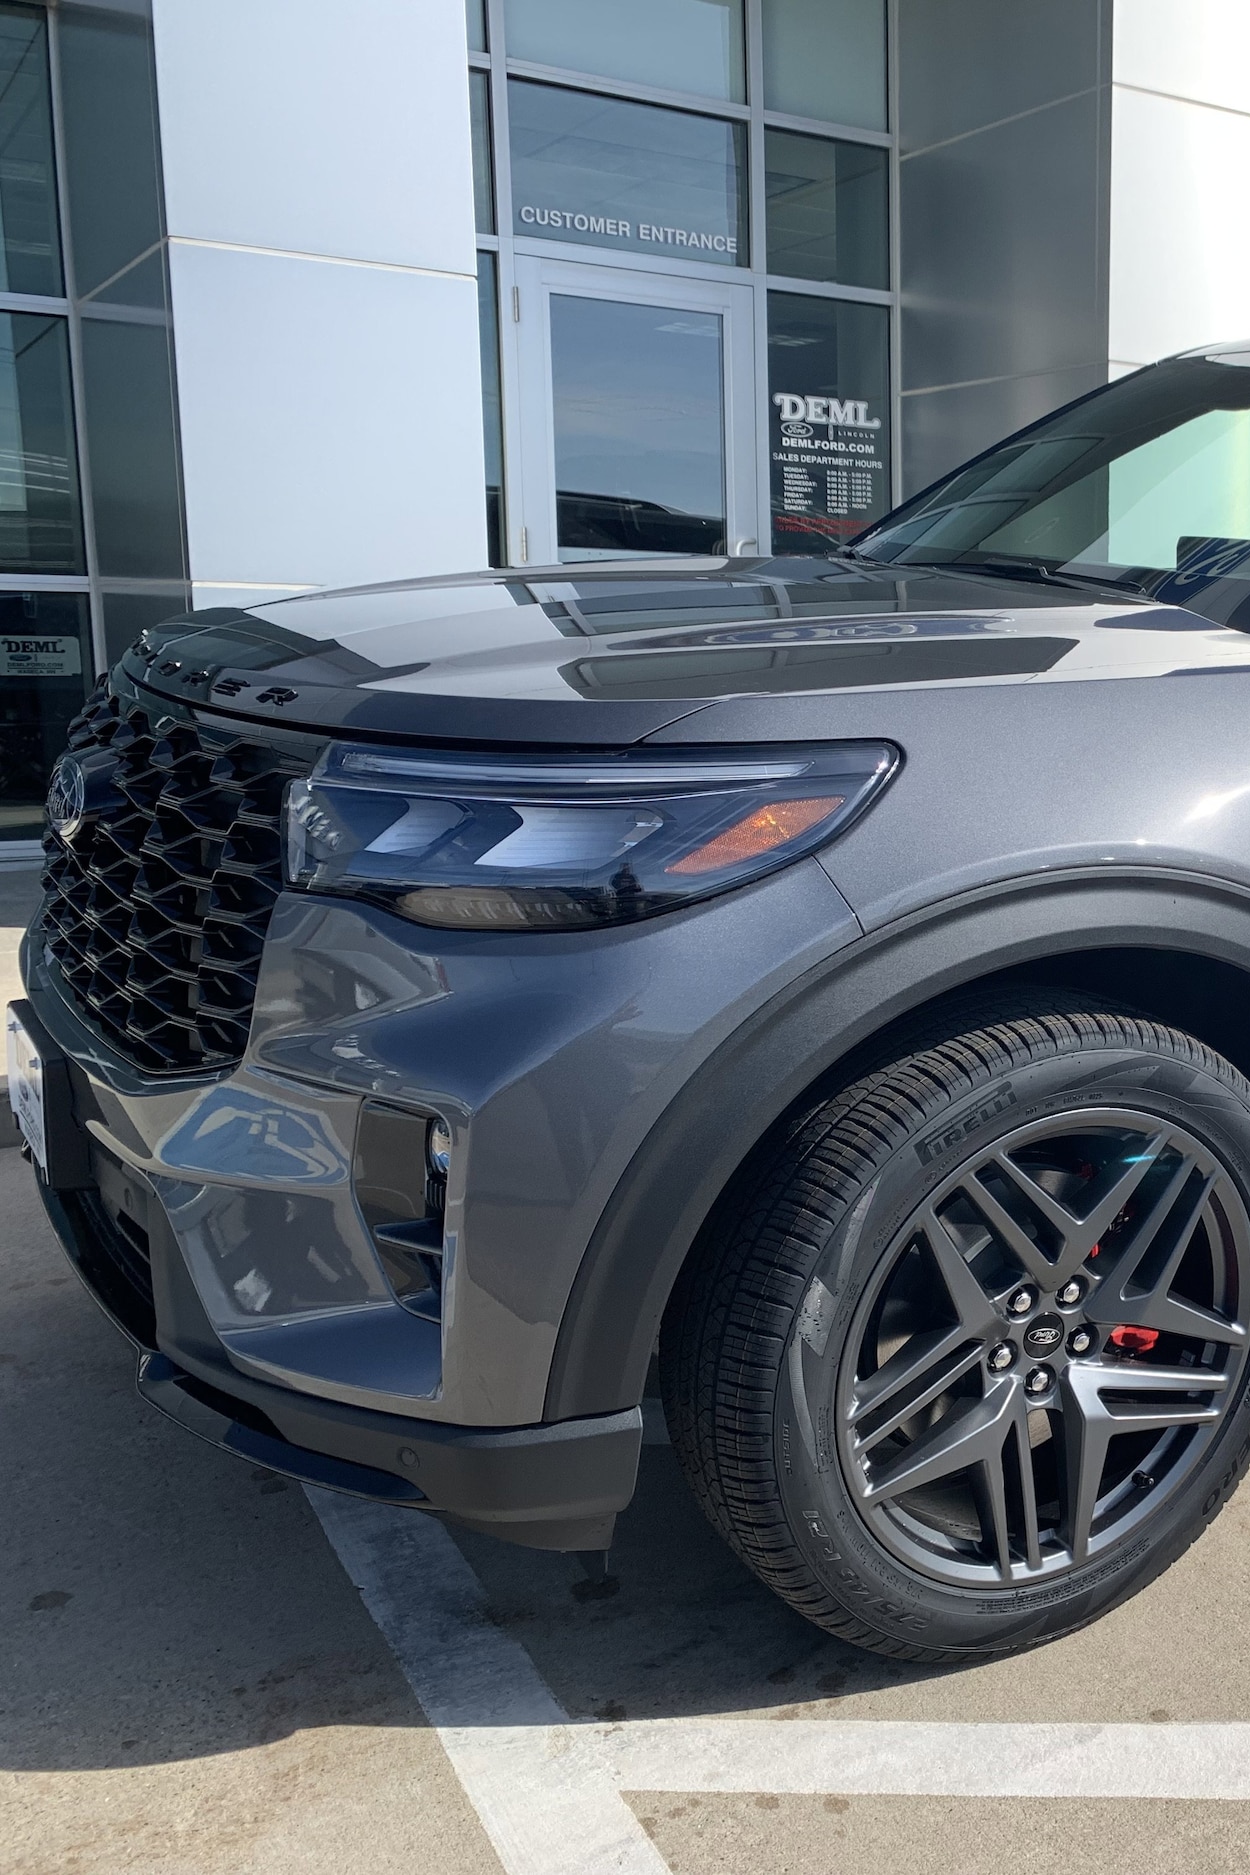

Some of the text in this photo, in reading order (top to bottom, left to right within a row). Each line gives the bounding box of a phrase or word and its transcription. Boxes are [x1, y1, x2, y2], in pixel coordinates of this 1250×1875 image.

[520, 206, 738, 254] CUSTOMER ENTRANCE
[773, 393, 881, 429] DEML
[838, 431, 875, 439] LINCOLN
[782, 437, 875, 454] DEMLFORD.COM
[773, 452, 883, 470] SALES DEPARTMENT HOURS
[1, 640, 65, 654] DEML
[913, 1080, 1018, 1167] PIRELLI
